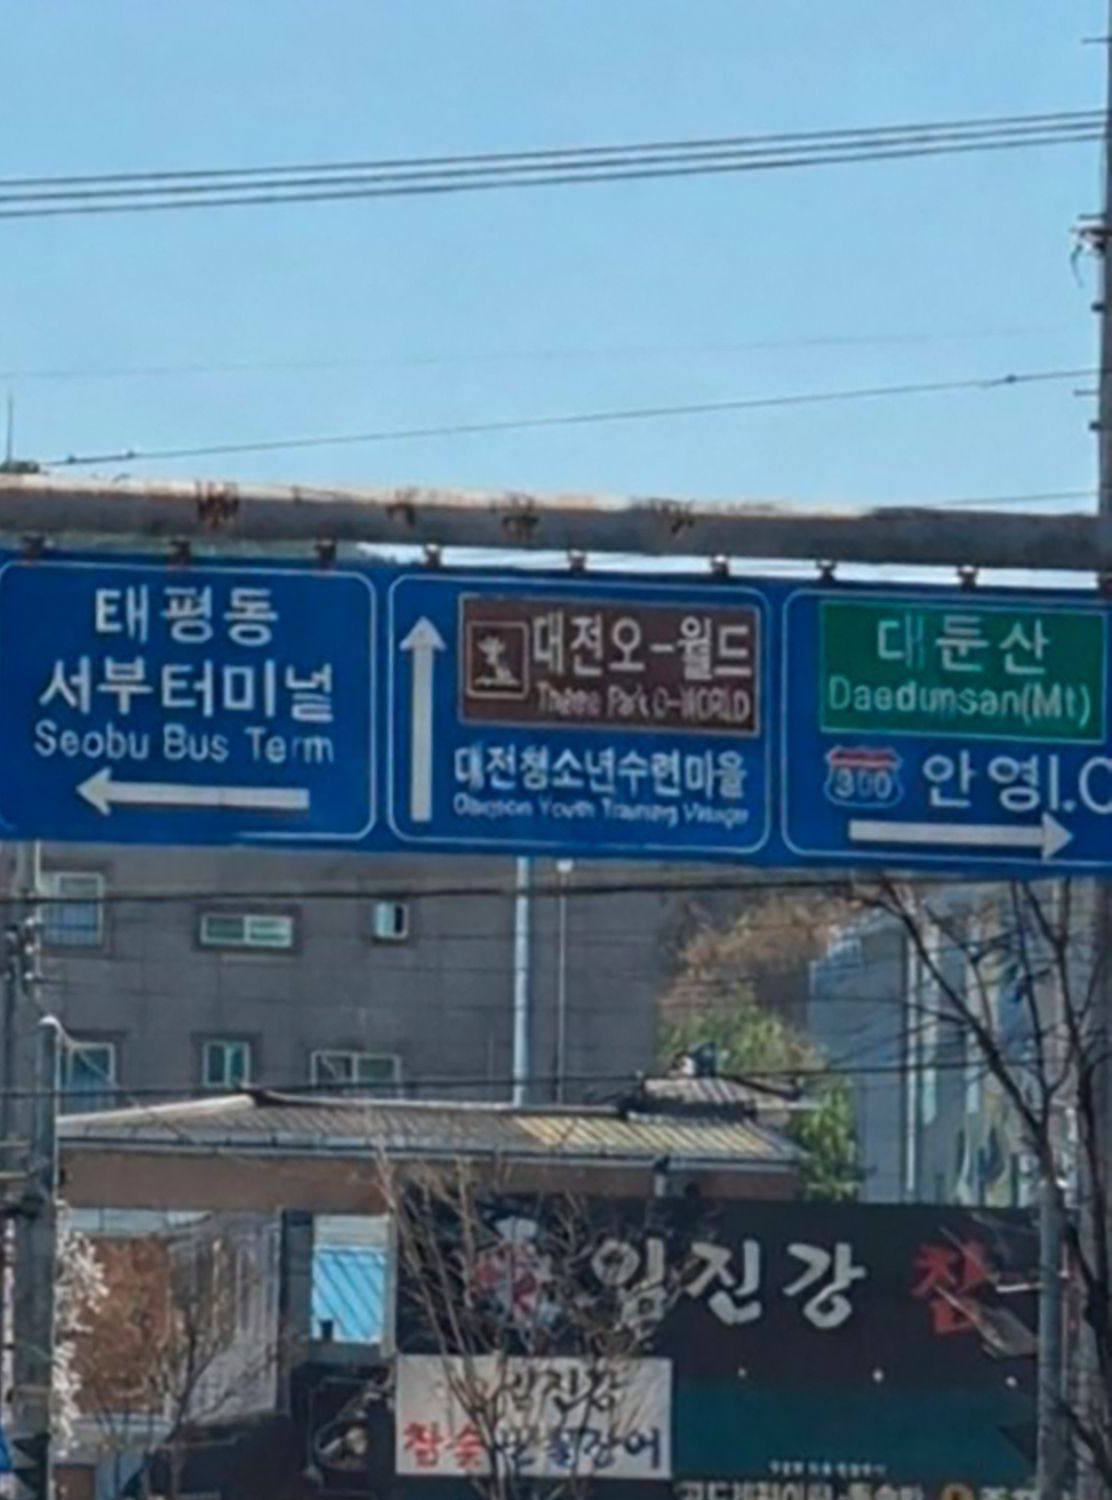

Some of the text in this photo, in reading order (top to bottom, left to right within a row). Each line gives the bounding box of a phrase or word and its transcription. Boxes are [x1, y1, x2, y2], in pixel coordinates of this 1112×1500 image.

[94, 583, 280, 647] 태평동
[876, 611, 1051, 676] 대둔산
[37, 654, 337, 724] 서부터미널
[33, 718, 335, 765] Seobu Bus Term
[591, 1236, 867, 1330] 임진강
